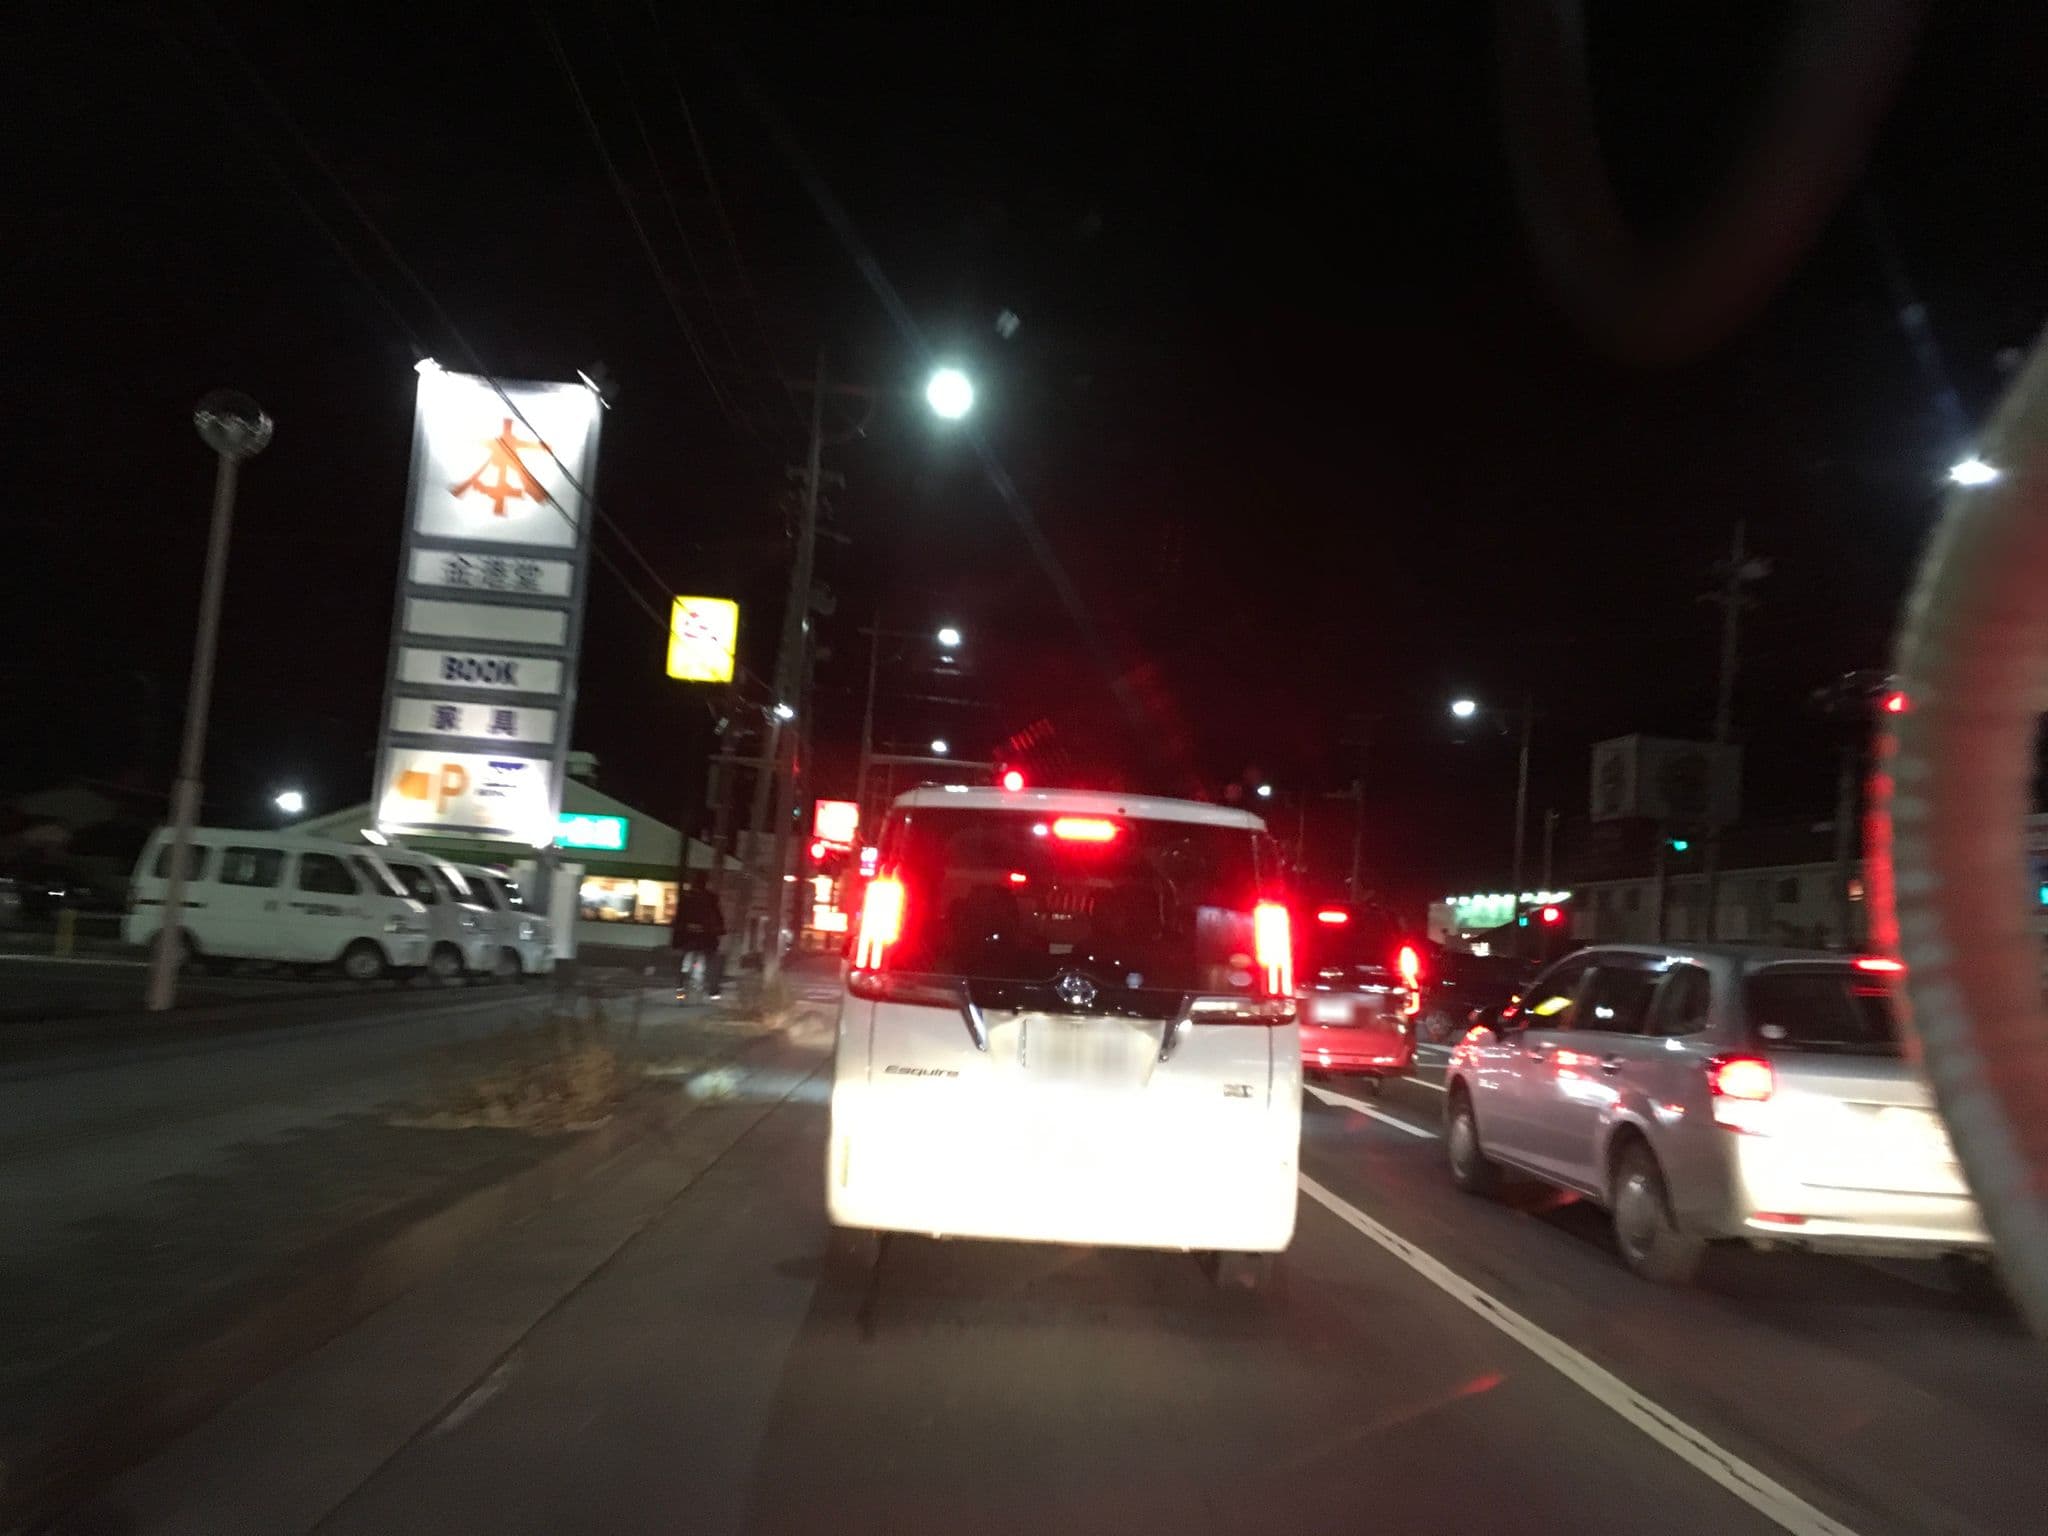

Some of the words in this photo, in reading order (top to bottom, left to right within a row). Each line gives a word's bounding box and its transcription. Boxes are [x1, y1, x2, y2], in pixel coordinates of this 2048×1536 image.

[449, 417, 551, 517] 本
[441, 656, 518, 686] BOOK
[437, 763, 469, 814] P
[885, 1065, 959, 1077] Esquire
